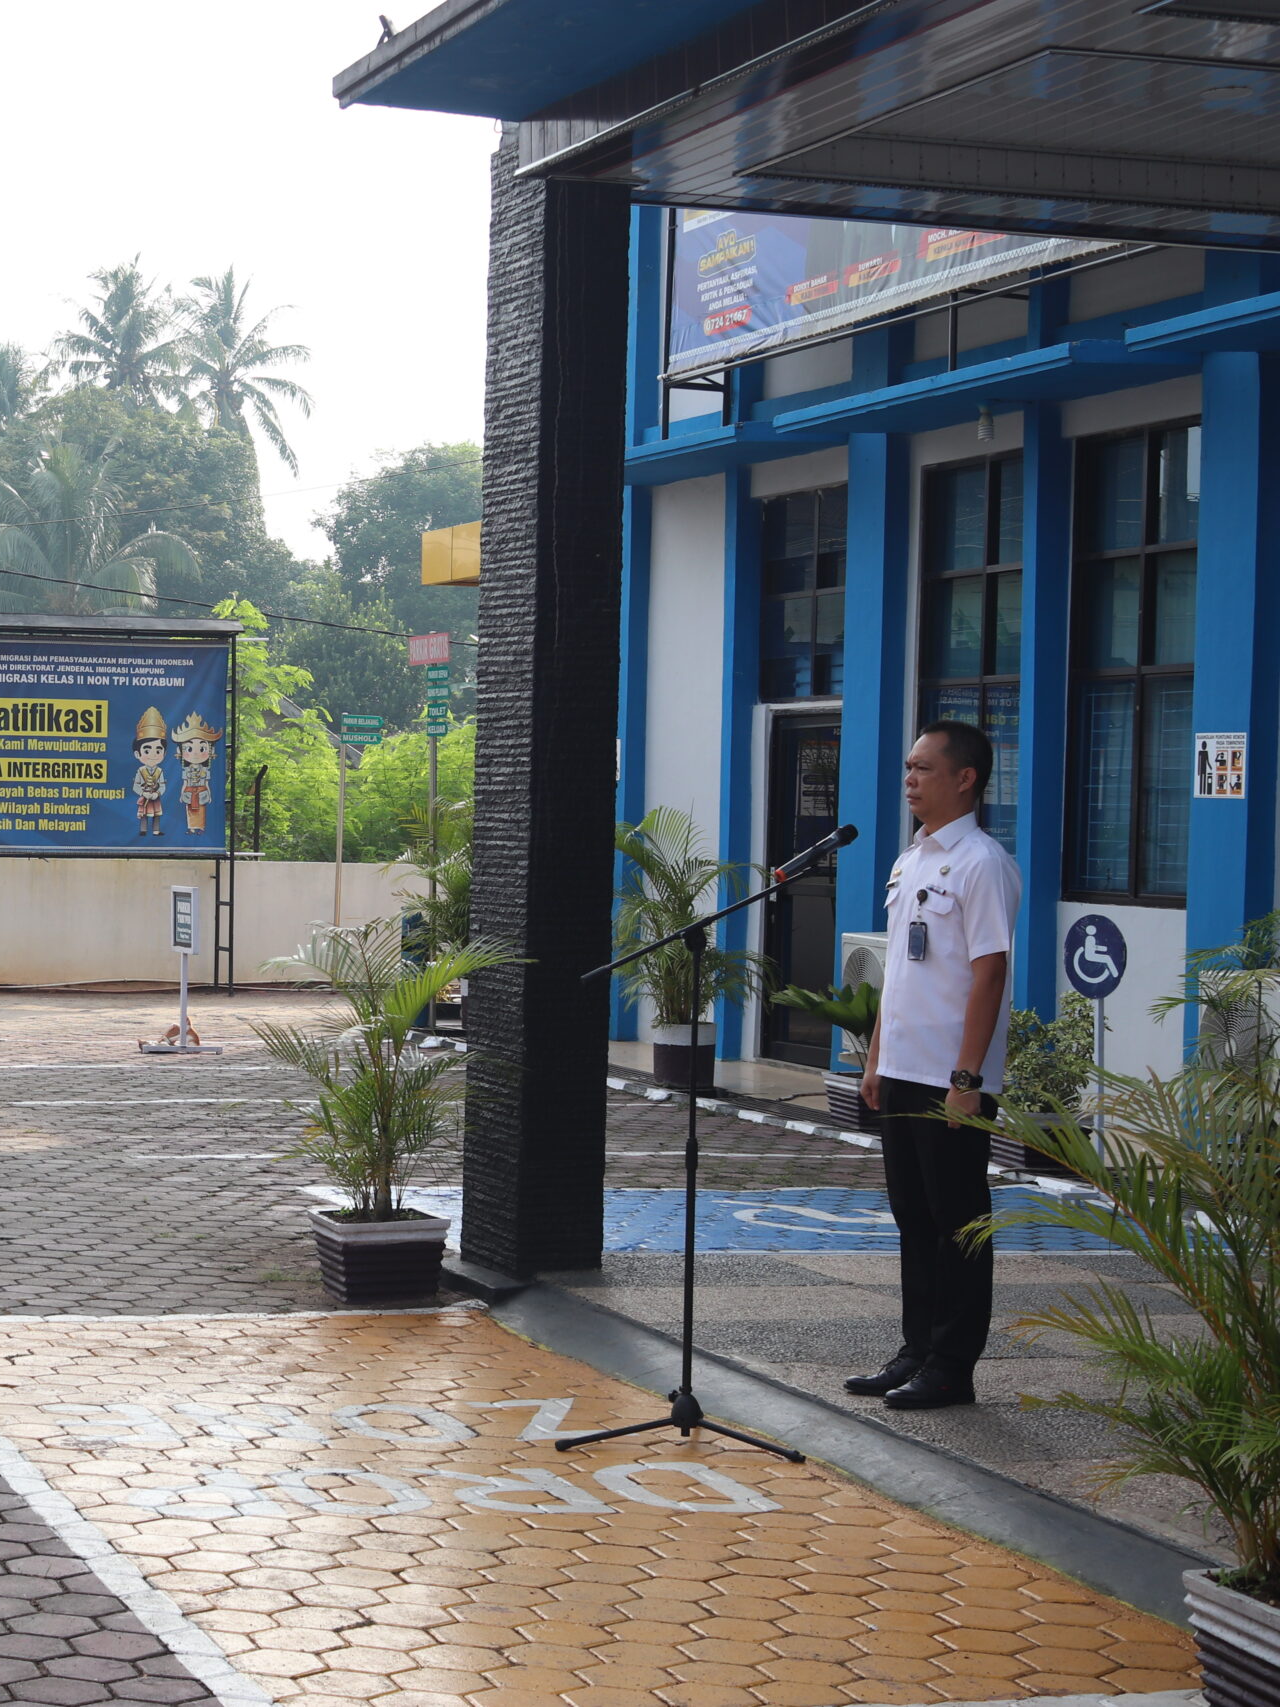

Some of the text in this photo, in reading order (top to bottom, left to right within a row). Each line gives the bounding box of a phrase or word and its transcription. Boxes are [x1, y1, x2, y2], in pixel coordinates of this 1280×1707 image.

[718, 232, 736, 250] AYO
[706, 317, 724, 330] 0724
[32, 655, 48, 663] DAN
[49, 656, 116, 664] PEMASYARAKATAN
[9, 663, 56, 672] DIREKTORAT
[56, 665, 94, 673] JENDERAL
[95, 666, 129, 674] IMIGRASI
[130, 667, 165, 675] LAMPUNG
[40, 674, 74, 684] KELAS
[77, 675, 84, 685] II
[87, 676, 110, 686] NON
[112, 676, 129, 686] TPI
[132, 677, 185, 687] KOTABUMI
[429, 706, 446, 716] TOILET
[342, 734, 378, 742] MUSHOLA
[27, 739, 106, 753] Mewujudkanya
[7, 761, 104, 779] INTERGRITAS
[27, 786, 59, 798] Bebas
[62, 787, 83, 799] Dari
[85, 787, 125, 801] Korupsi
[43, 803, 90, 815] Birokrasi
[15, 819, 35, 831] Dan
[38, 819, 86, 832] Melayani
